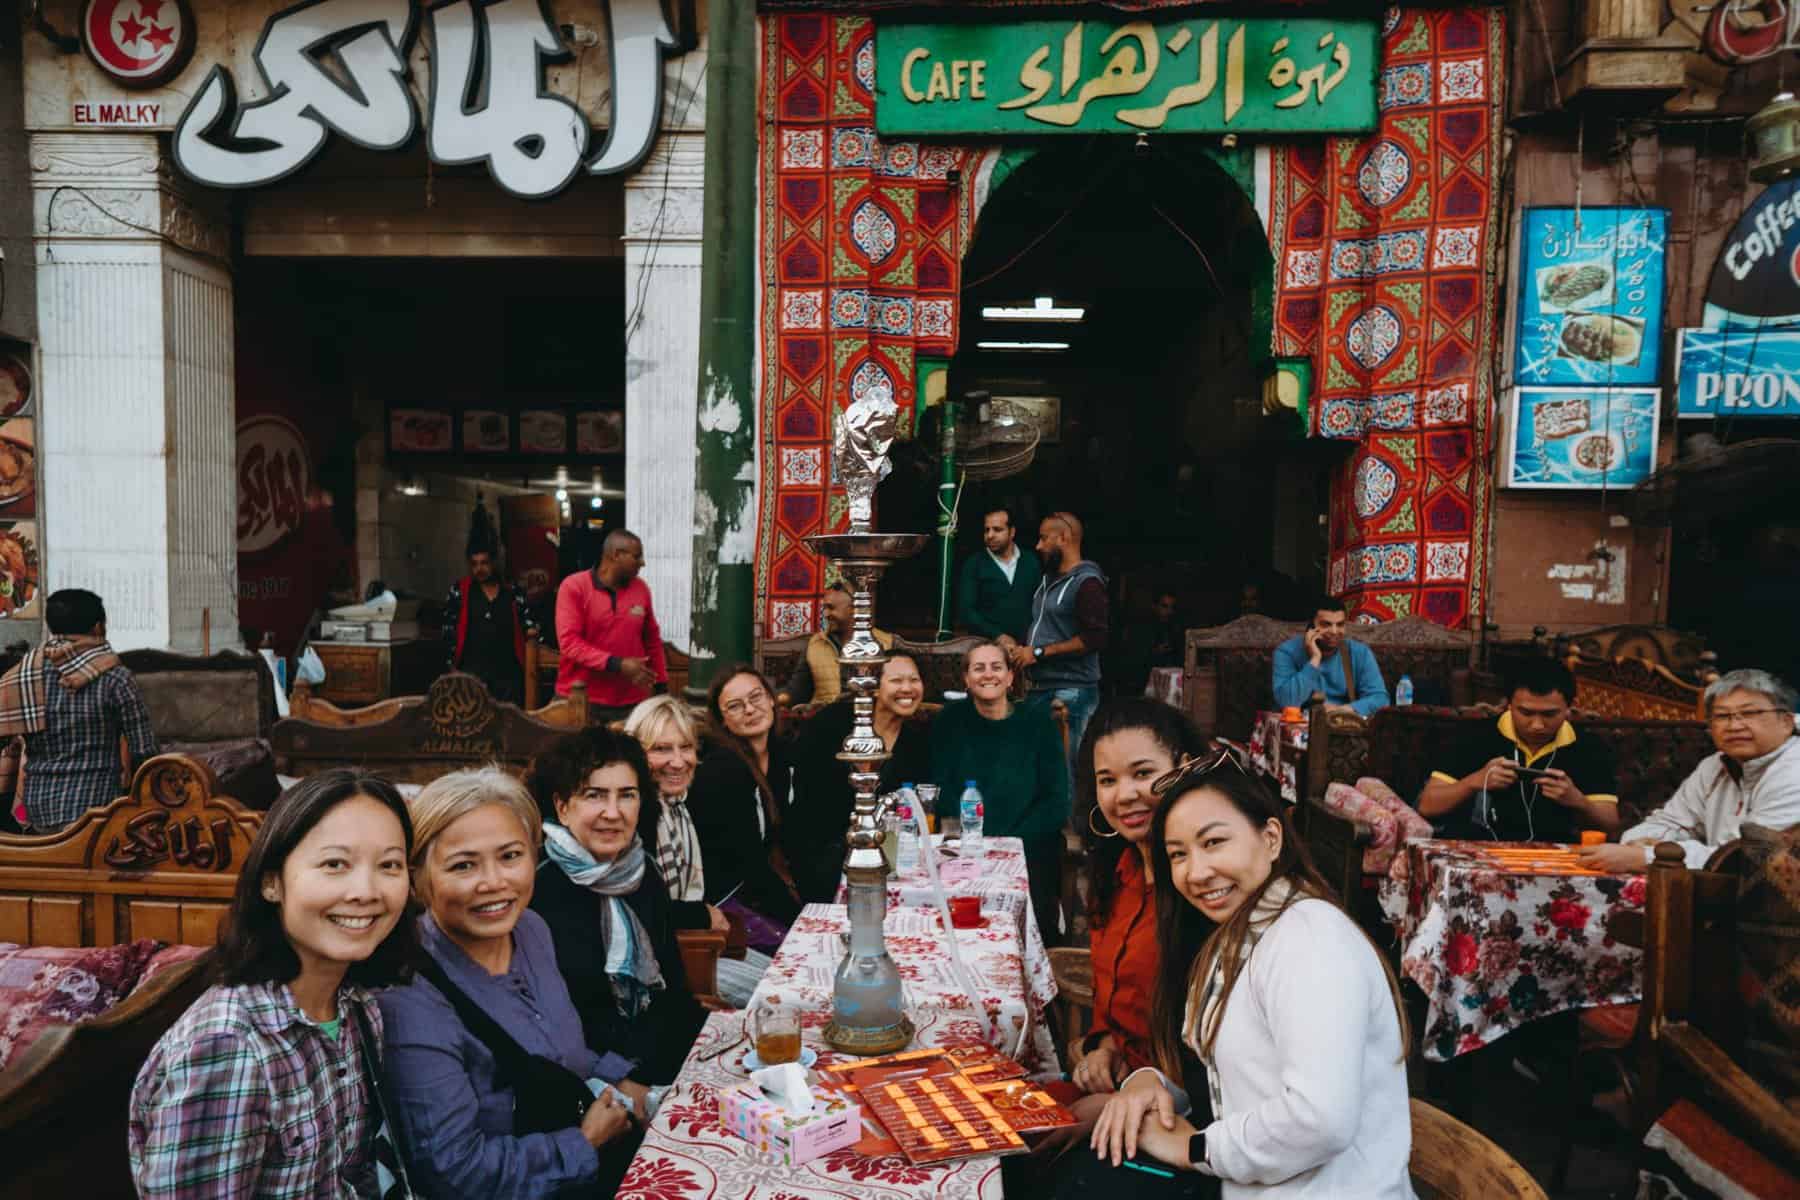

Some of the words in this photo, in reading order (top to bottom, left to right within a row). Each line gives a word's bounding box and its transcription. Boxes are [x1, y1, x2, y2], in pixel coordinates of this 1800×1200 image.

[901, 47, 988, 102] CAFE
[996, 20, 1245, 129] الزهراء
[1267, 31, 1351, 109] قهوة
[74, 104, 97, 123] EL
[99, 104, 160, 123] MALKY
